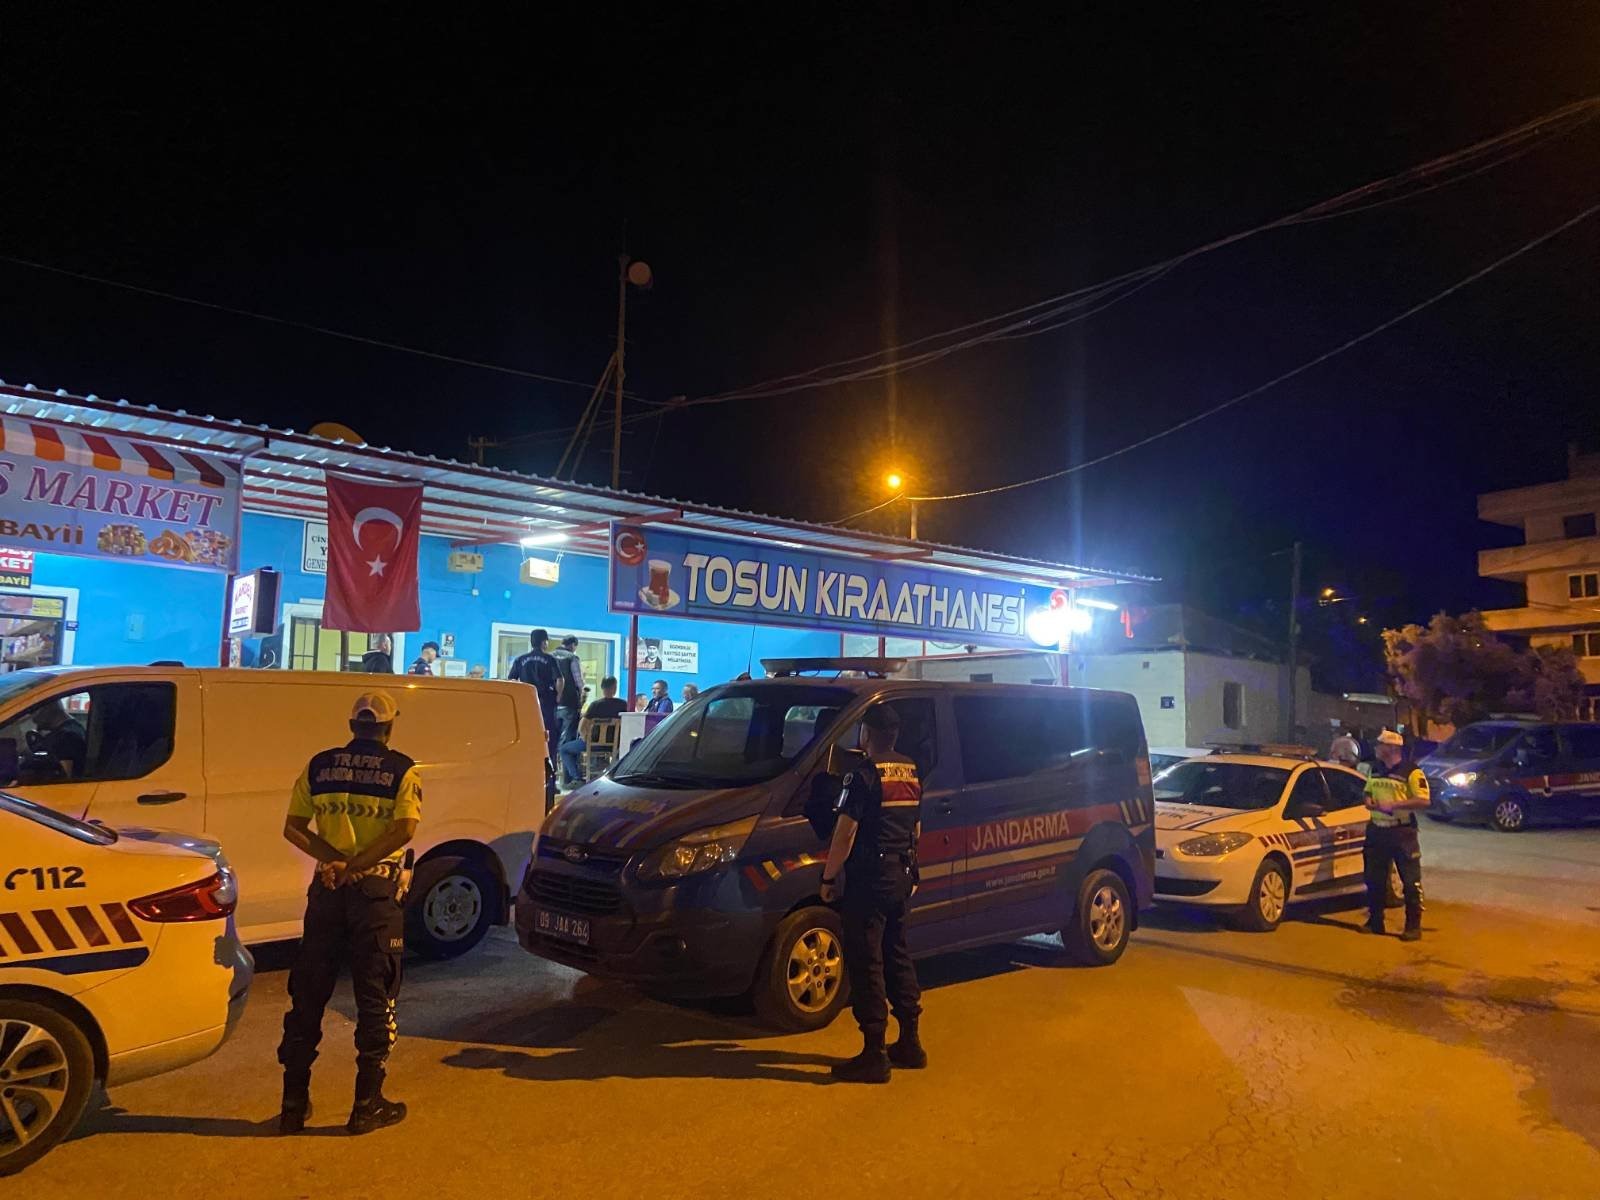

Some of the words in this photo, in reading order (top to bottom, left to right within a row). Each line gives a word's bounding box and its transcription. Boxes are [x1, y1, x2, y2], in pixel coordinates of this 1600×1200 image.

[23, 466, 223, 528] MARKET
[683, 553, 808, 613] TOSUN
[815, 570, 1025, 635] KIRAATHANESİ
[971, 811, 1070, 852] JANDARMA
[30, 865, 87, 891] 112
